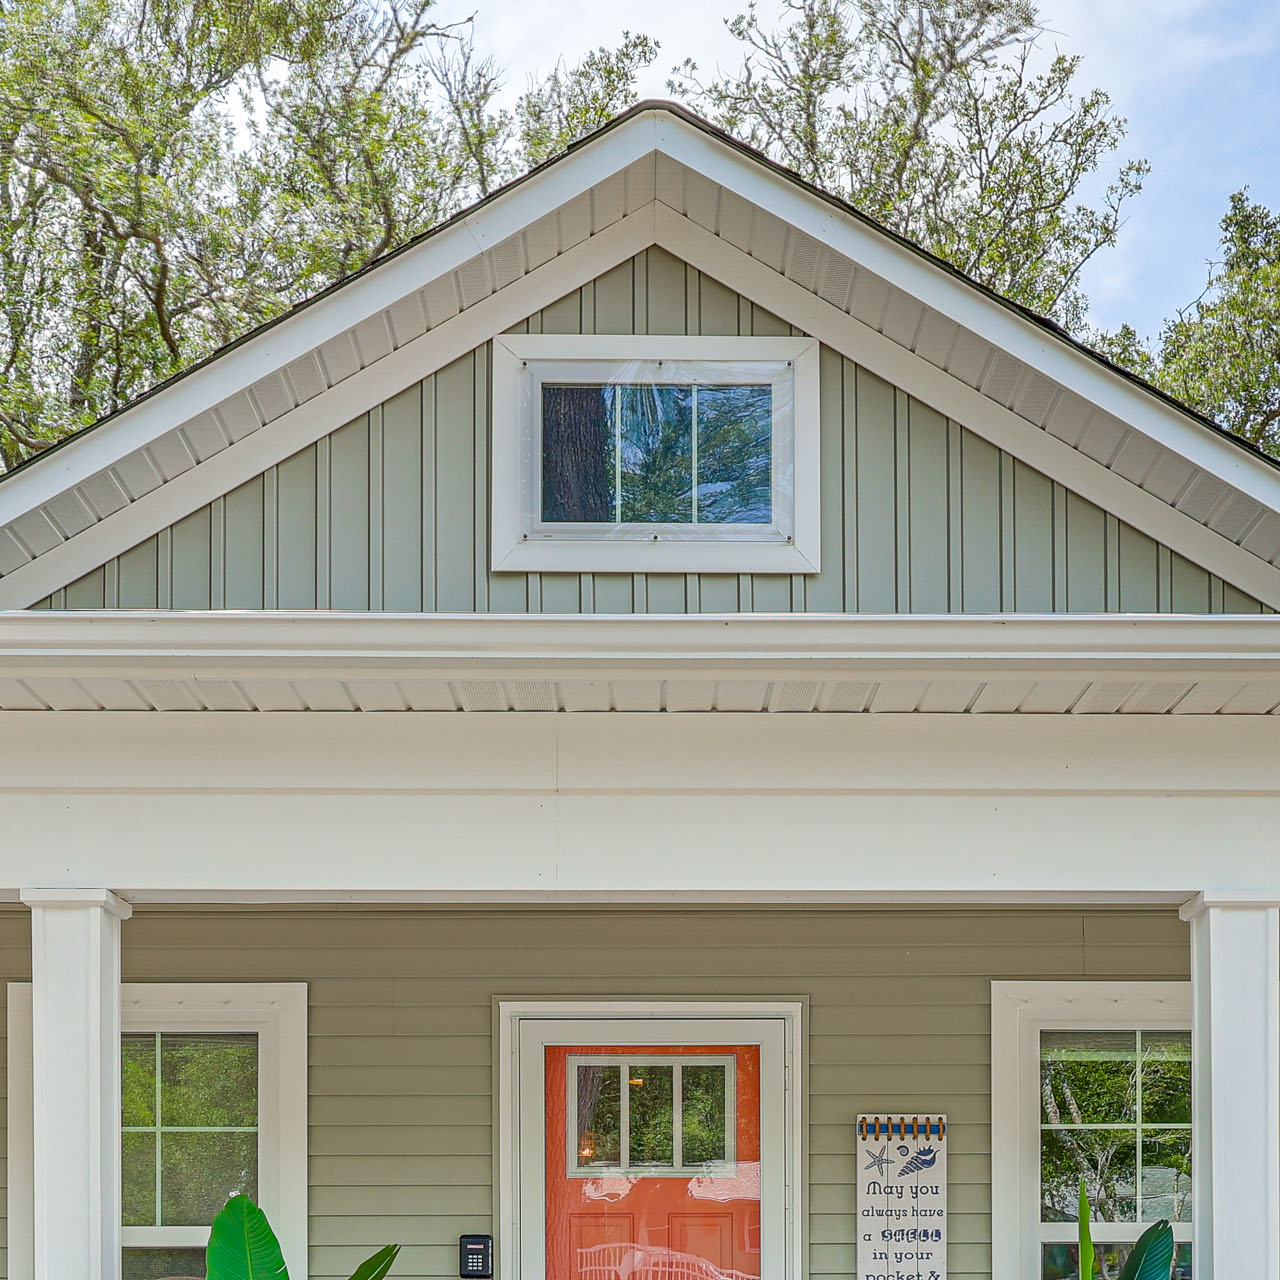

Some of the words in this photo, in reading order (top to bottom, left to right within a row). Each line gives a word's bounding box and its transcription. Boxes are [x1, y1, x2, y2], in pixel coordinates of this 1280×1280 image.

[866, 1181, 904, 1199] May
[909, 1185, 940, 1199] you
[861, 1206, 908, 1220] always
[911, 1206, 944, 1217] have
[863, 1233, 872, 1241] a
[881, 1228, 941, 1243] SHELL
[872, 1249, 888, 1260] in
[894, 1252, 933, 1263] your
